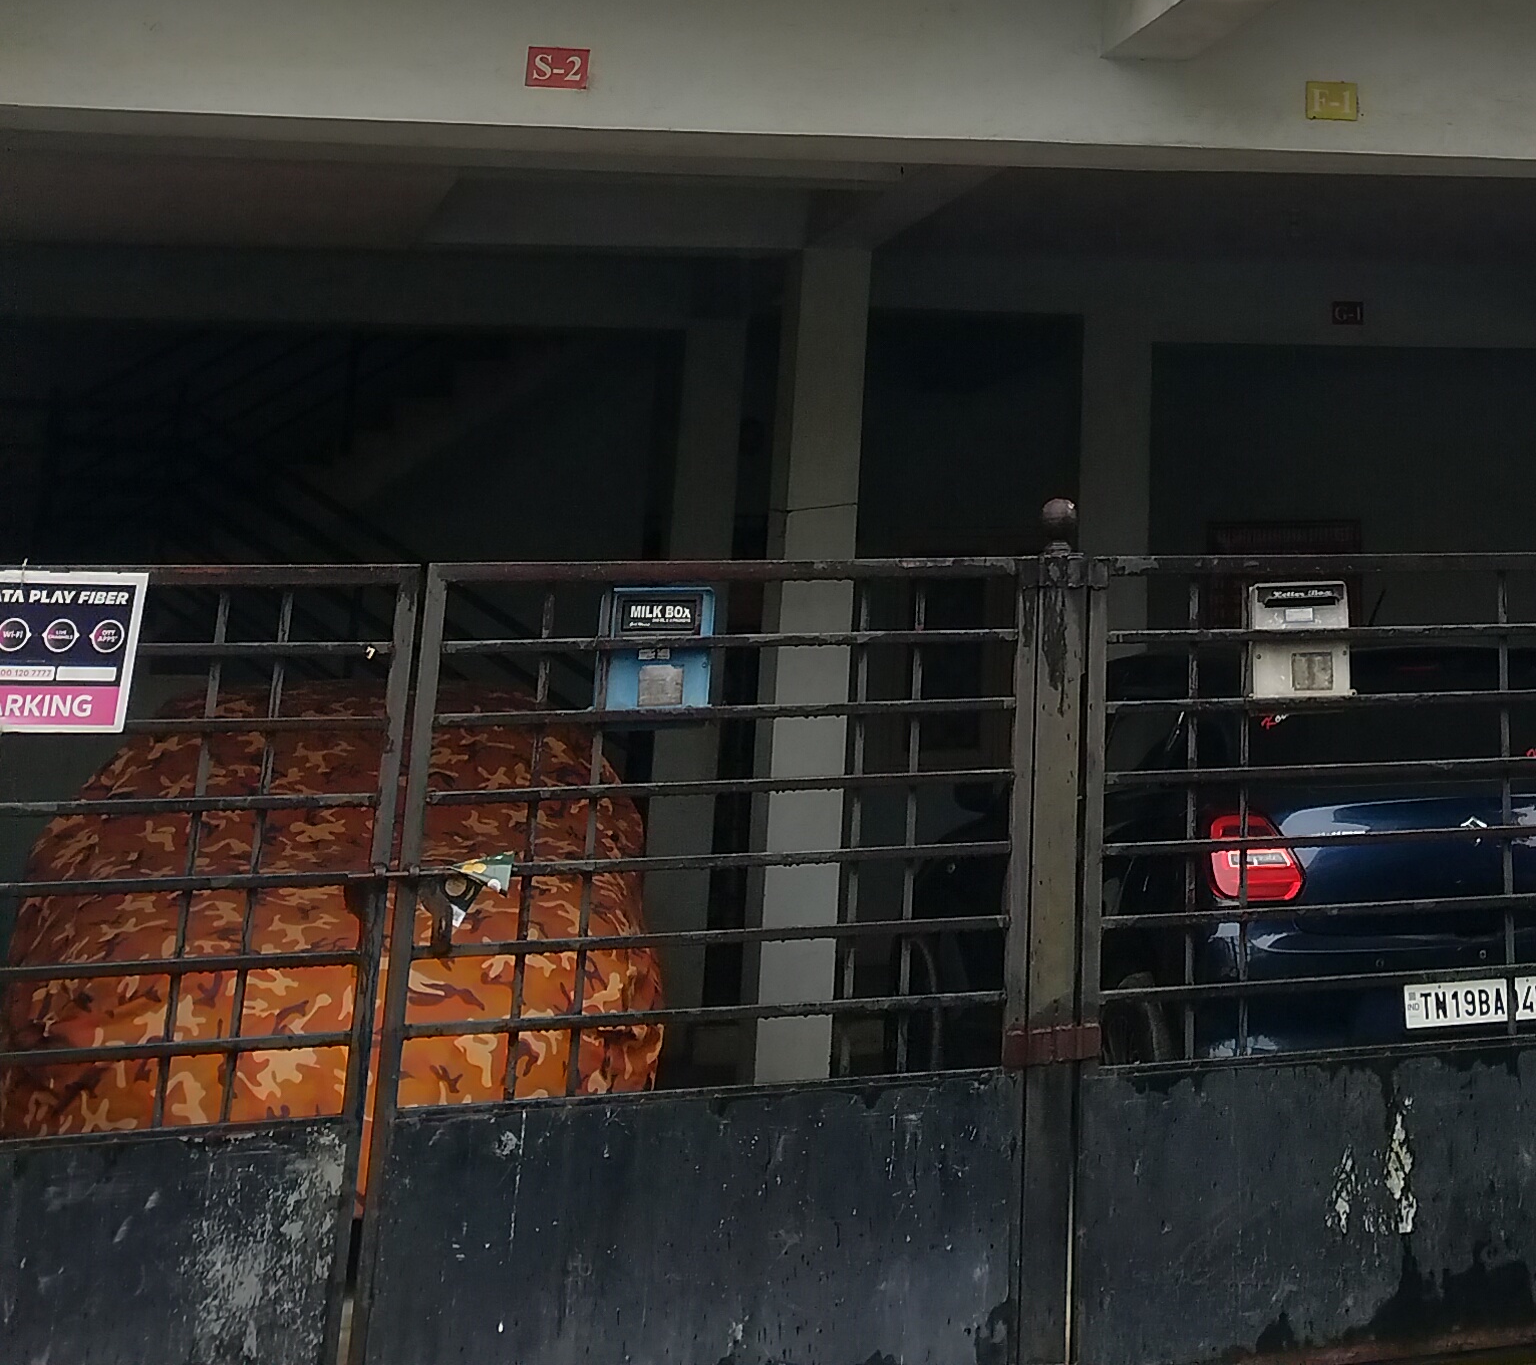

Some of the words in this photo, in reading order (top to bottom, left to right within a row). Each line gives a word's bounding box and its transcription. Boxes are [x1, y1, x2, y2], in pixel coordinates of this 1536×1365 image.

[532, 54, 582, 81] S-2
[1312, 88, 1352, 114] F-1
[1334, 306, 1361, 321] G-1
[0, 589, 24, 603] TA
[29, 590, 75, 604] PLAY
[78, 591, 129, 605] FIBER
[630, 605, 663, 618] MILK
[0, 694, 93, 718] RKING
